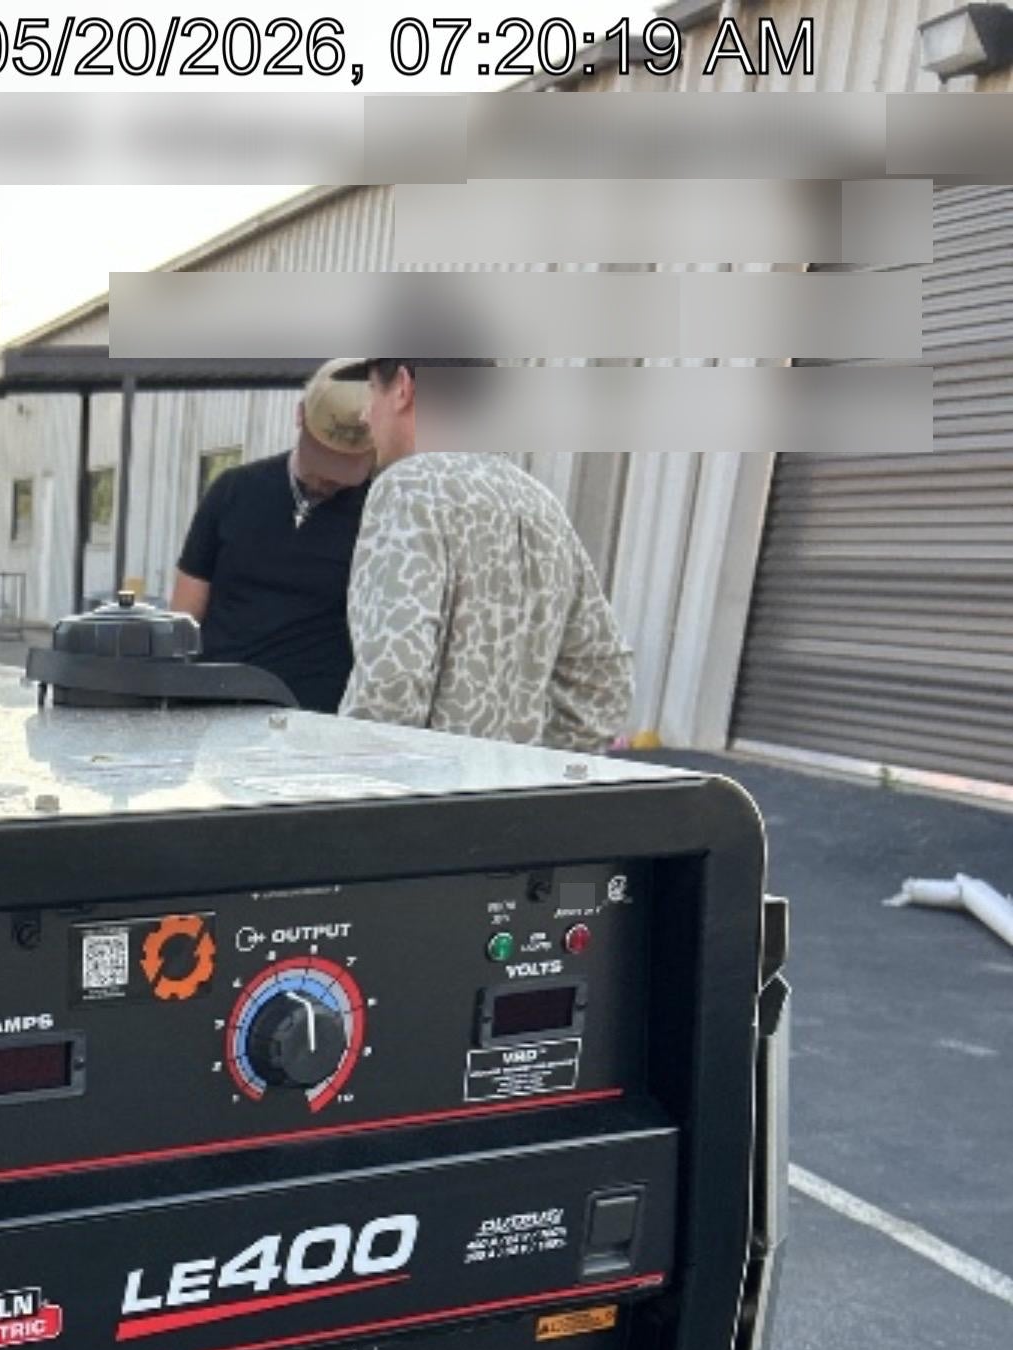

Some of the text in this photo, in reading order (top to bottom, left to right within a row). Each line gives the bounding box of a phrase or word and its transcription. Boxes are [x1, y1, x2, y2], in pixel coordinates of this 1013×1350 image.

[271, 922, 352, 943] OUTPUT
[505, 958, 565, 979] VOLTS
[121, 1214, 419, 1315] LE400
